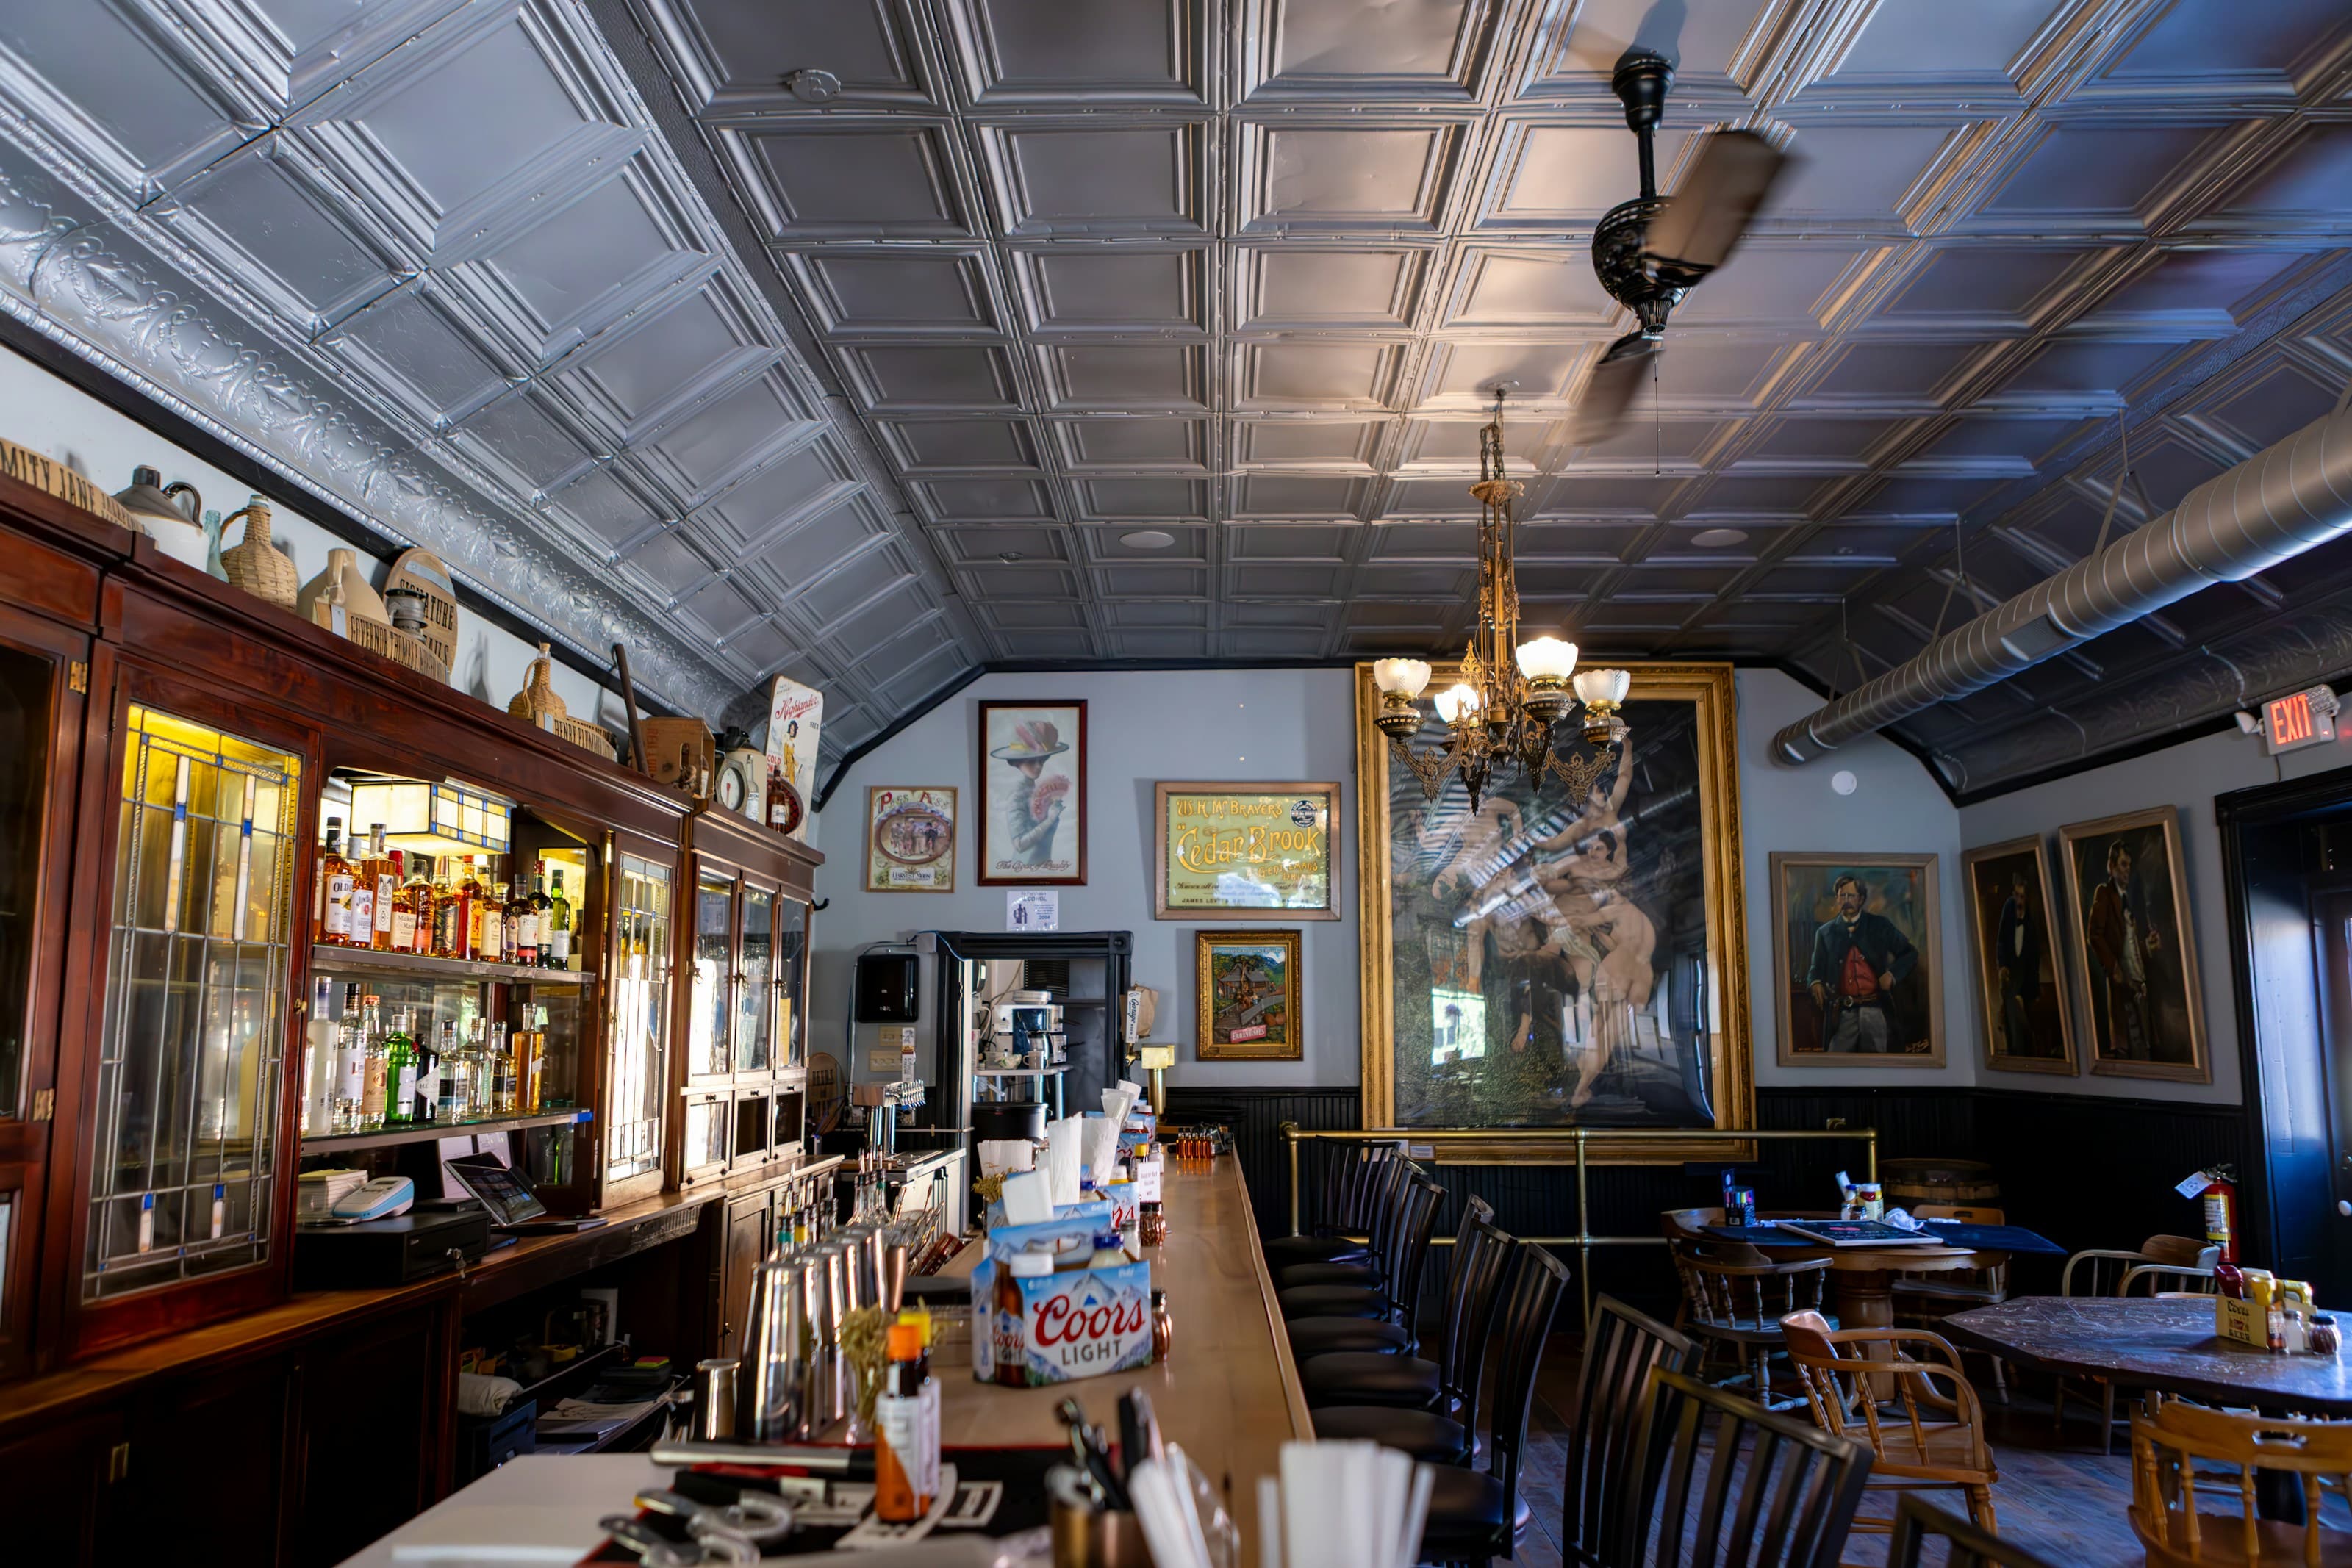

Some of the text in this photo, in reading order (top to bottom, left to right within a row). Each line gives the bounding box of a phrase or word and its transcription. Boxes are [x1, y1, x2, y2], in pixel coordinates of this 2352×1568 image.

[350, 615, 388, 657] GOVERNOR
[775, 694, 820, 722] Highlander
[2270, 693, 2313, 745] EXIT
[767, 754, 781, 766] COLD
[1248, 826, 1321, 863] Brook
[1033, 1293, 1145, 1348] Coors
[1061, 1339, 1122, 1367] LIGHT
